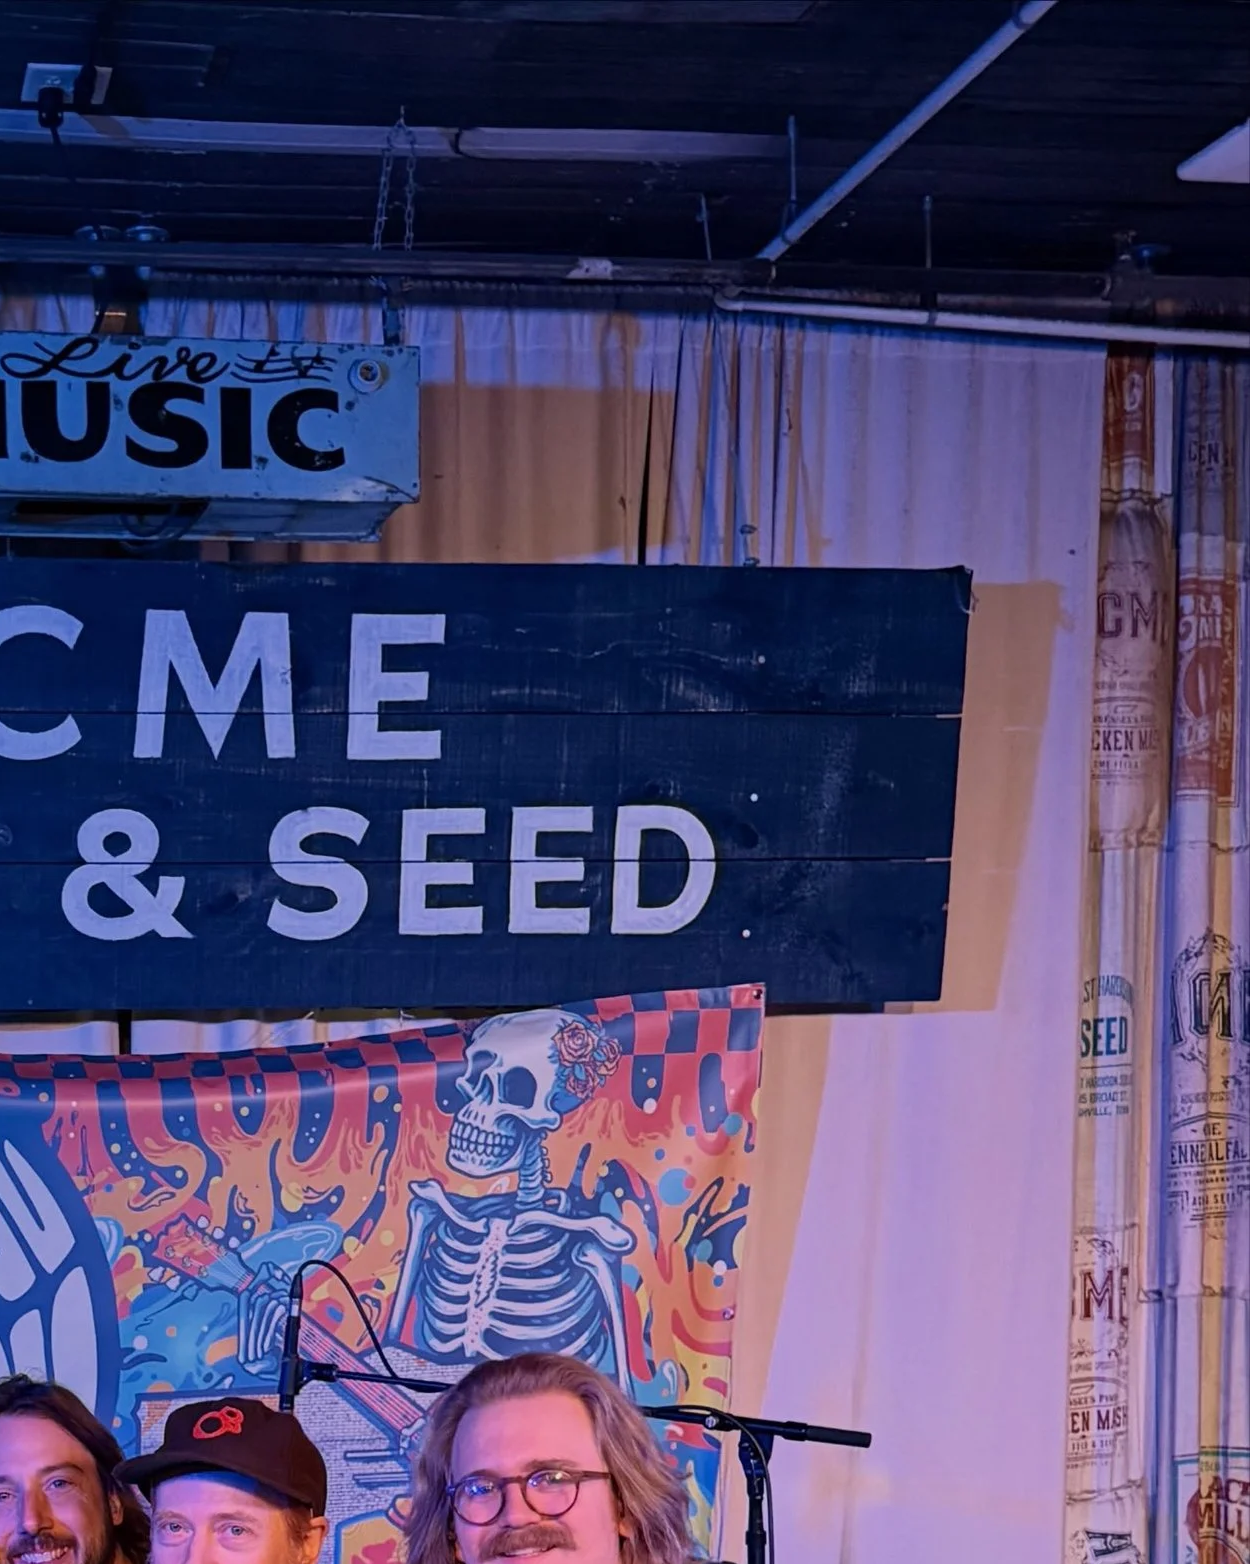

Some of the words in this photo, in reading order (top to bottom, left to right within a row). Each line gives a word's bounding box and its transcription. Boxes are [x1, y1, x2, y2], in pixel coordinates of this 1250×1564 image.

[0, 336, 231, 384] Live
[61, 808, 193, 941] &
[267, 804, 716, 941] SEED
[1080, 1016, 1129, 1059] SEED
